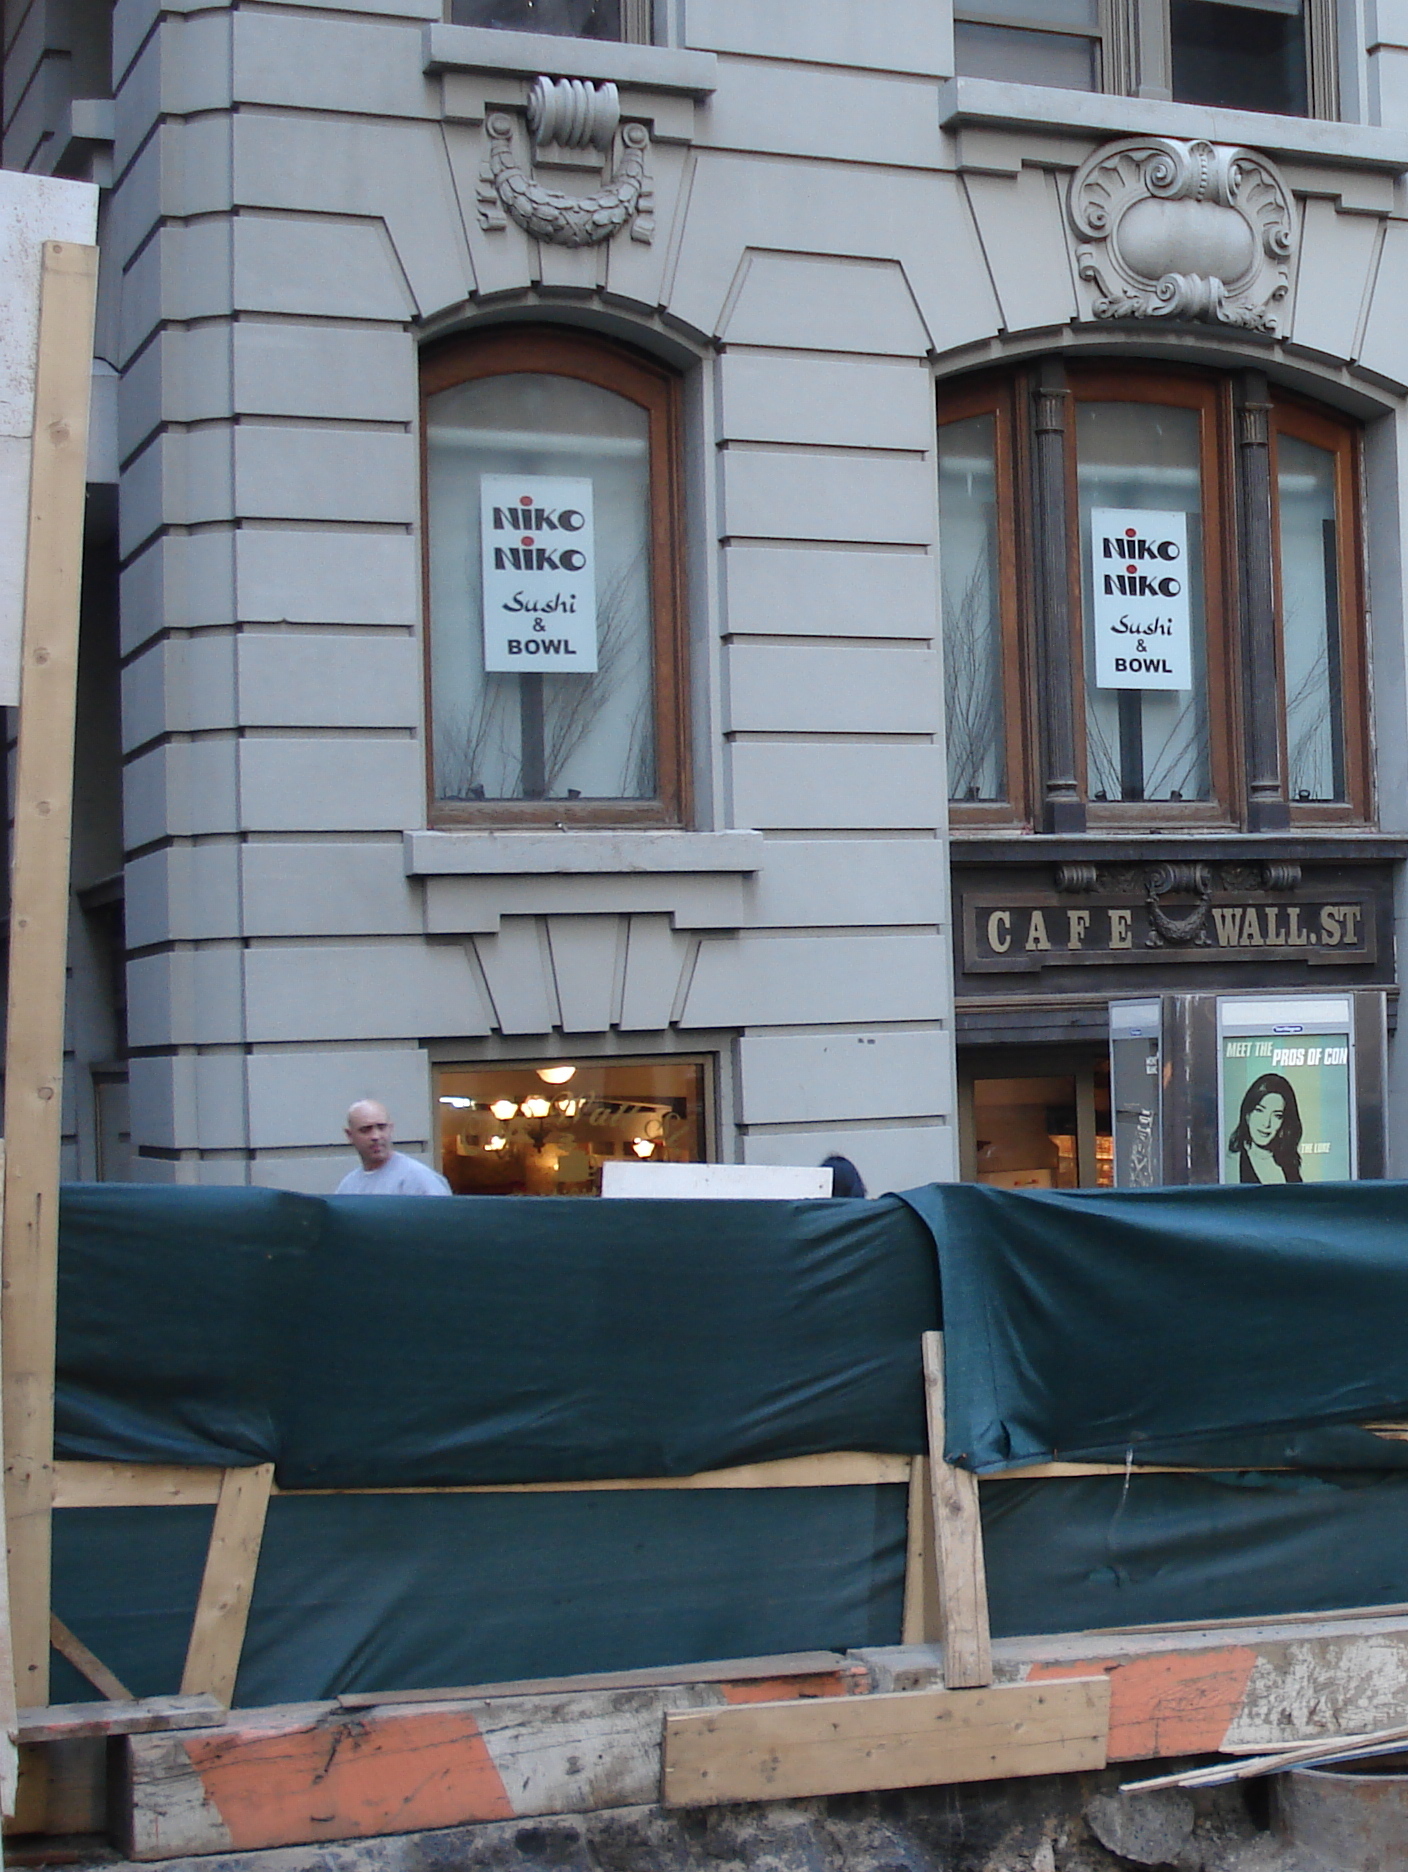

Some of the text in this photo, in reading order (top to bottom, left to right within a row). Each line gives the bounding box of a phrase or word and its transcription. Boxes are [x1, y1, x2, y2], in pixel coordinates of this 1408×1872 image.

[502, 590, 577, 614] Sushi
[532, 617, 547, 632] &
[1110, 614, 1173, 636] Sushi
[507, 639, 577, 655] BOWL
[1136, 638, 1148, 652] &
[1115, 658, 1173, 673] BOWL
[987, 910, 1133, 953] CAFE
[1226, 1041, 1273, 1057] MEET THE
[1272, 1048, 1304, 1066] PROS
[1306, 1048, 1322, 1066] OF
